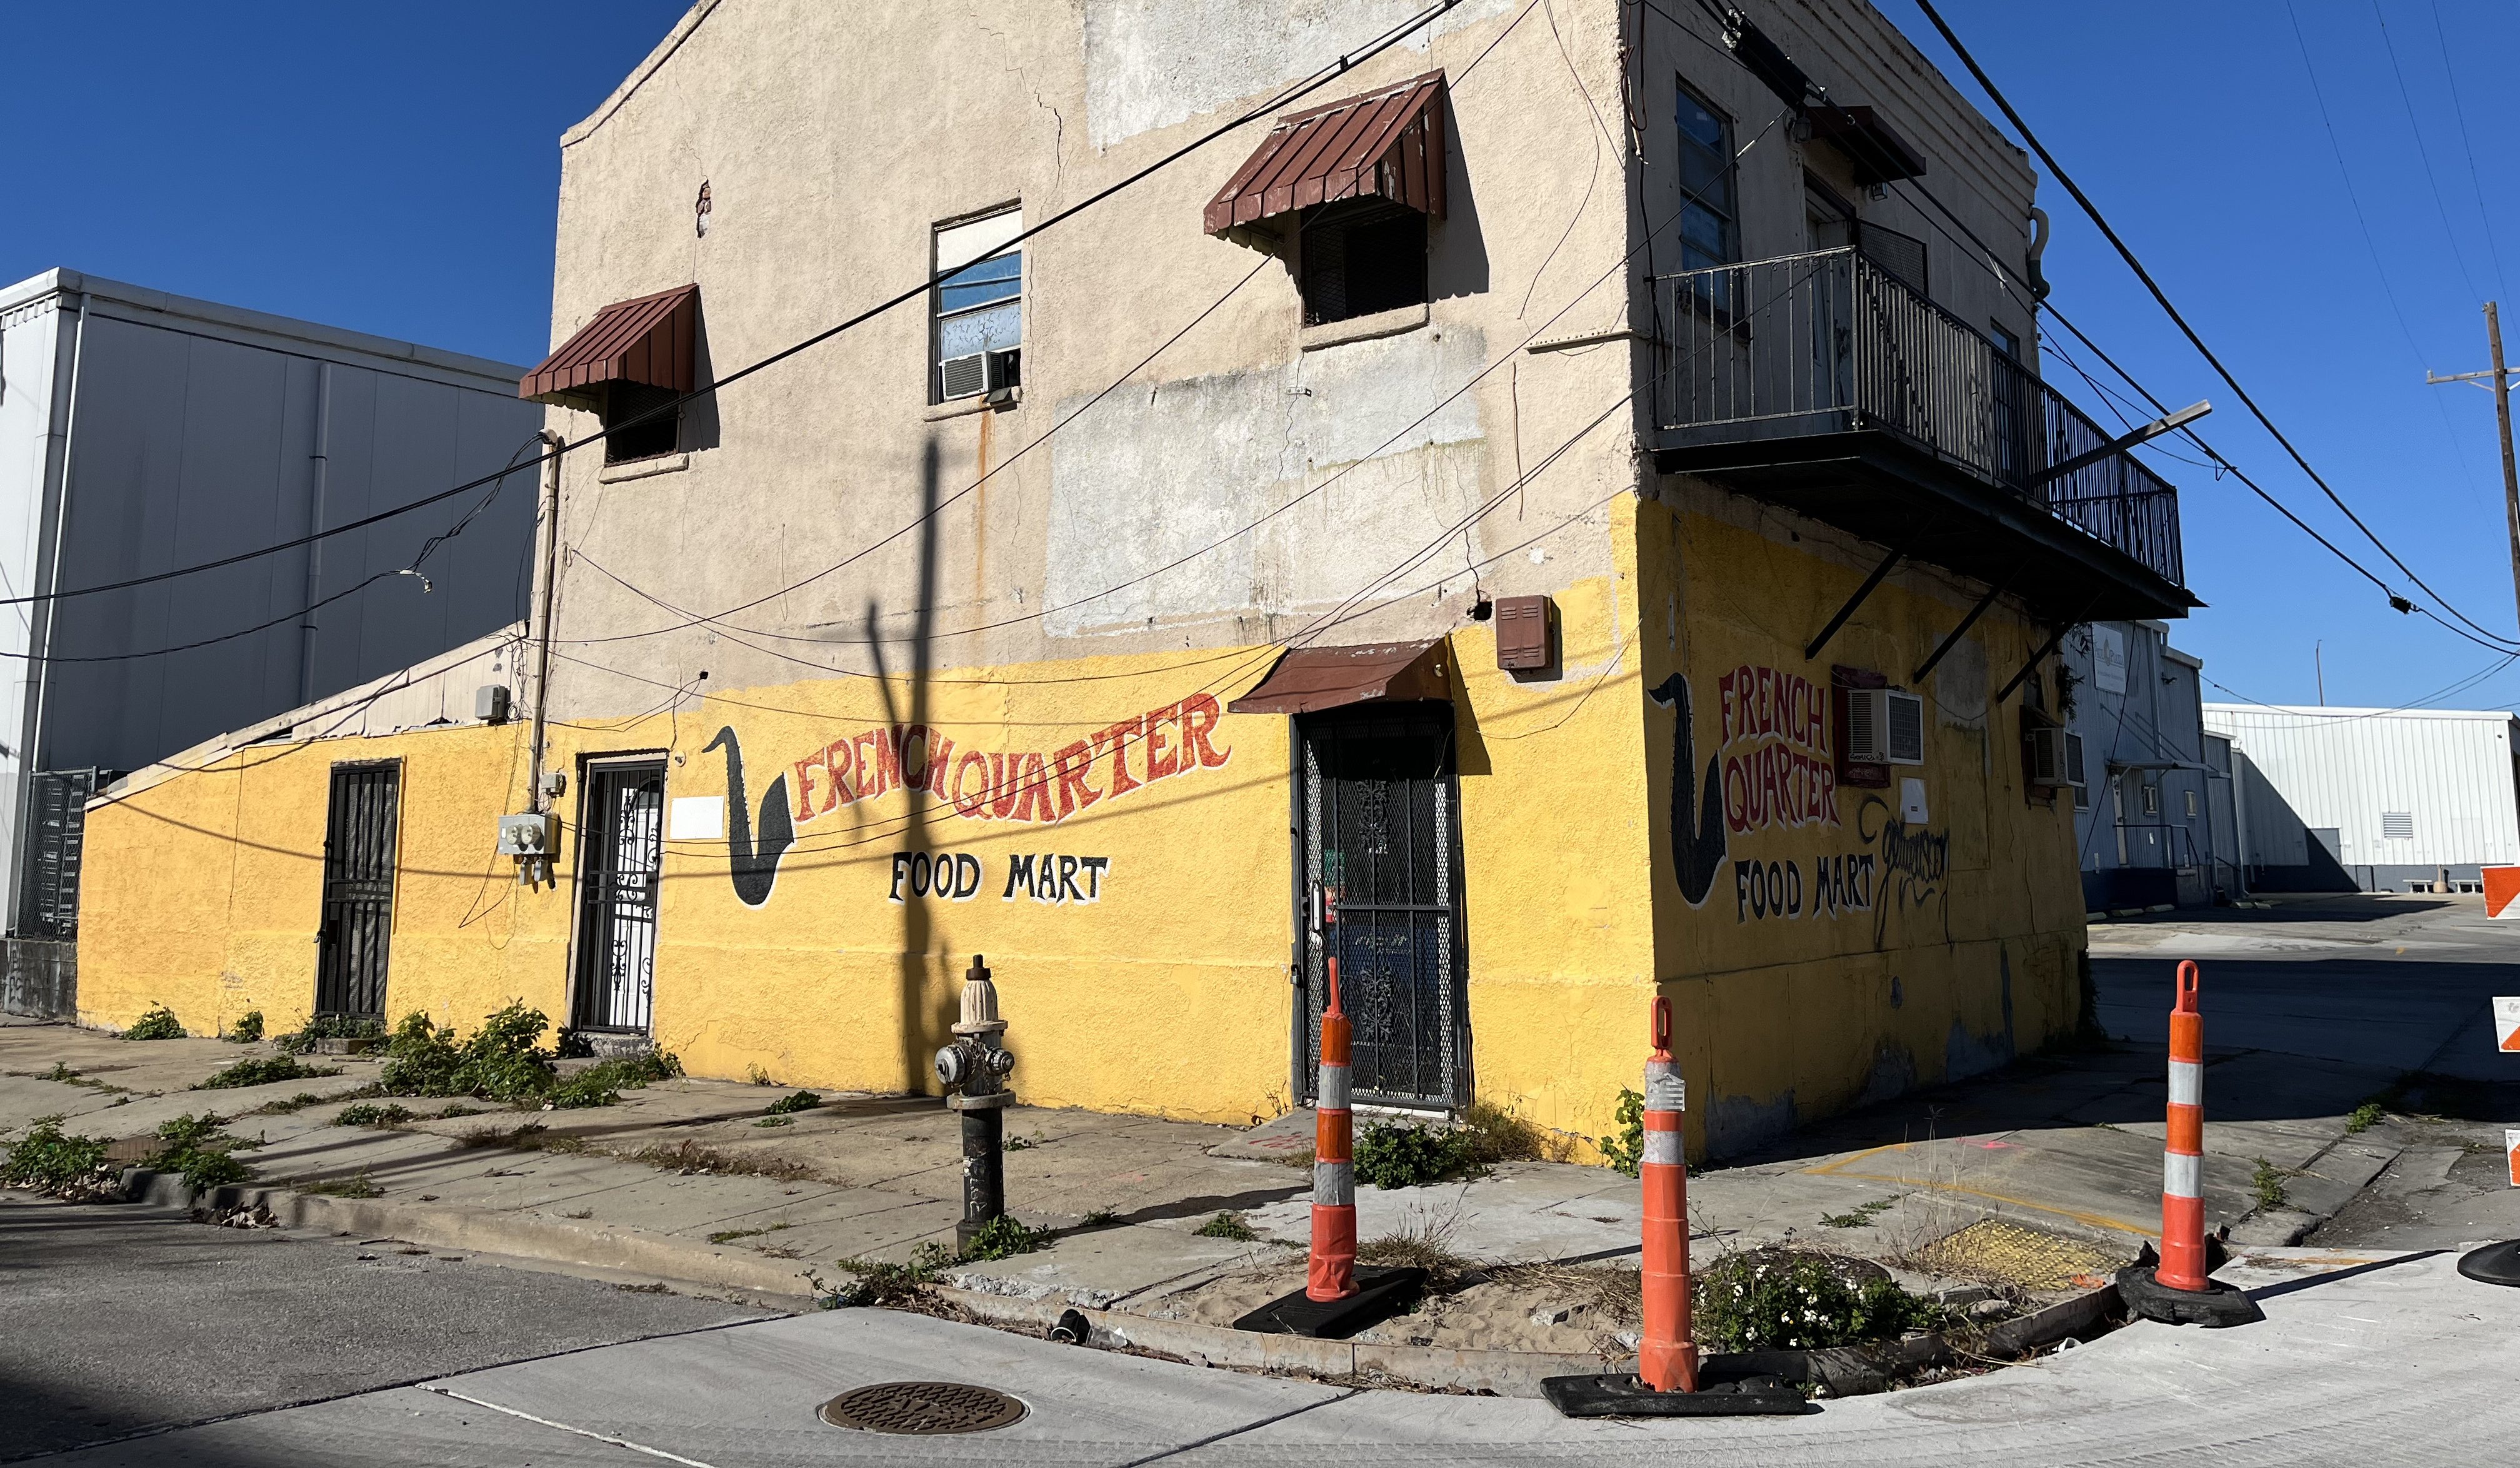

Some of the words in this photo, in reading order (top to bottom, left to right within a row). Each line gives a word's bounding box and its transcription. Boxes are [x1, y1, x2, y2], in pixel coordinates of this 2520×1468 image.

[1718, 665, 1829, 757] FRENCH
[793, 723, 956, 823] FRENCH
[953, 691, 1231, 825] QUARTER
[1724, 743, 1842, 835] QUARTER
[889, 852, 981, 903] FOOD
[1002, 853, 1109, 905] MART
[1734, 859, 1802, 924] FOOD
[1812, 853, 1876, 920] MART
